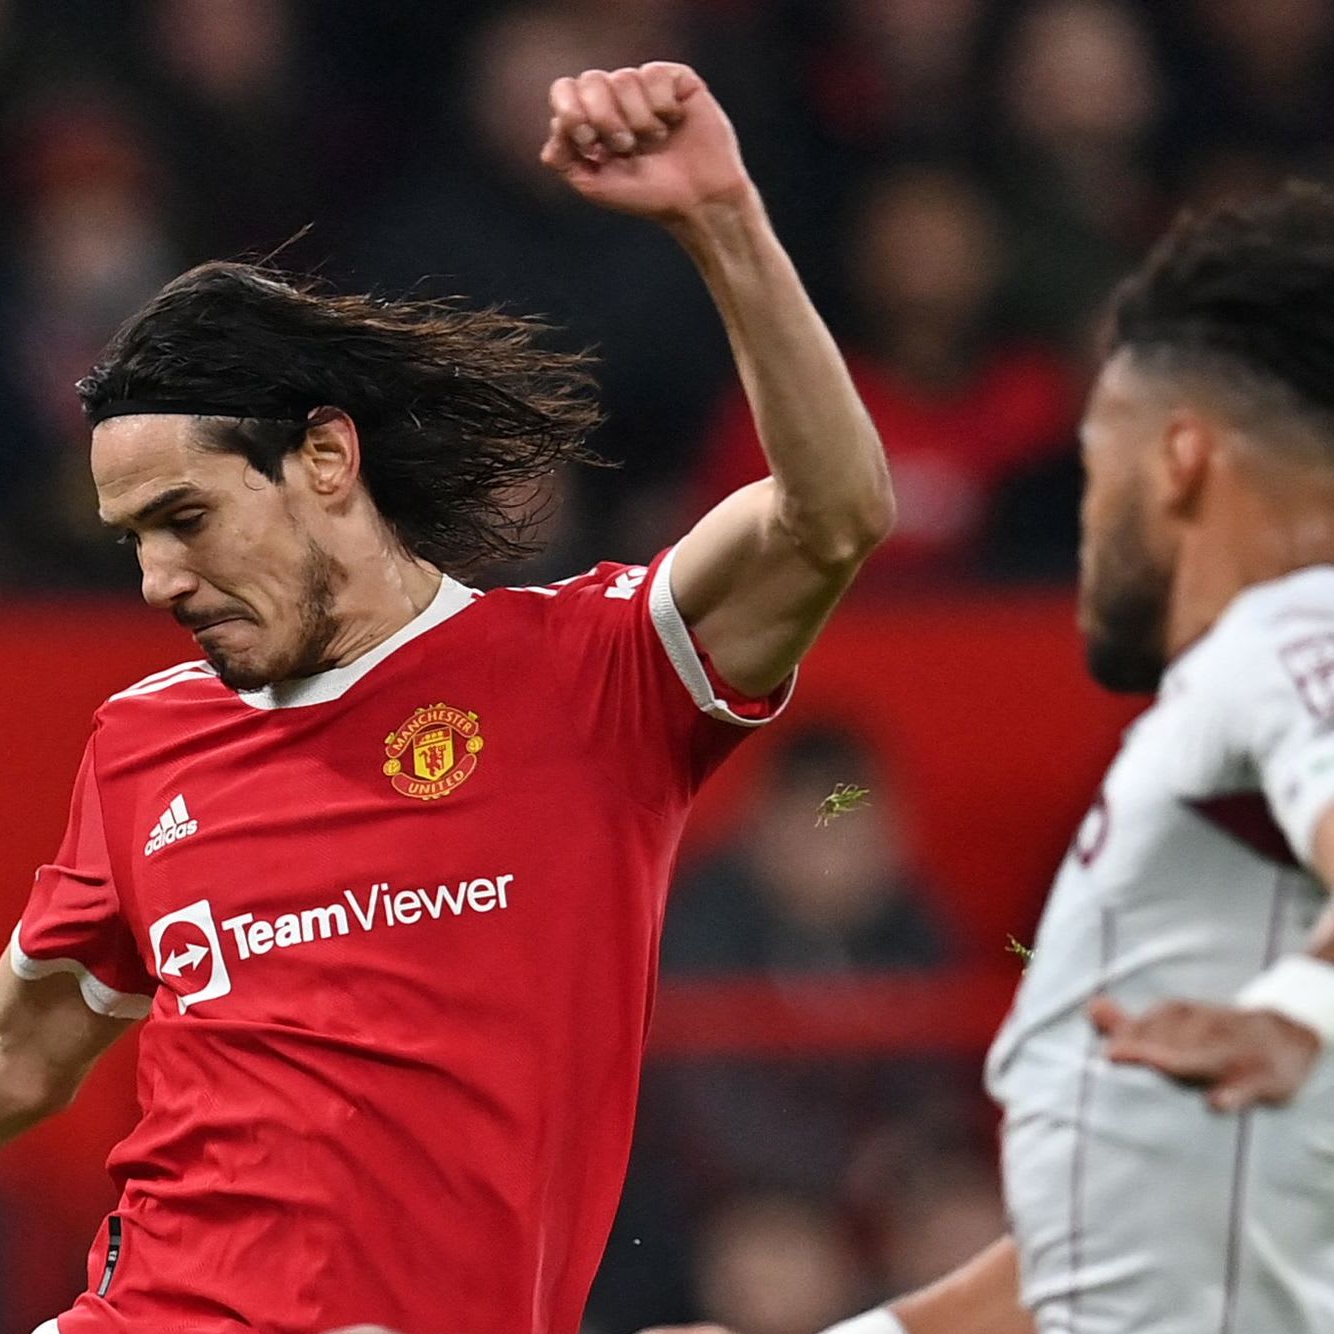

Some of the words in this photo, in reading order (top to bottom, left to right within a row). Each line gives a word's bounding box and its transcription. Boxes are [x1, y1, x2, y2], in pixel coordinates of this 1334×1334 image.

[392, 710, 473, 751] MANCHESTER
[408, 769, 465, 794] UNITED
[144, 818, 198, 857] adidas
[221, 873, 514, 960] TeamViewer
